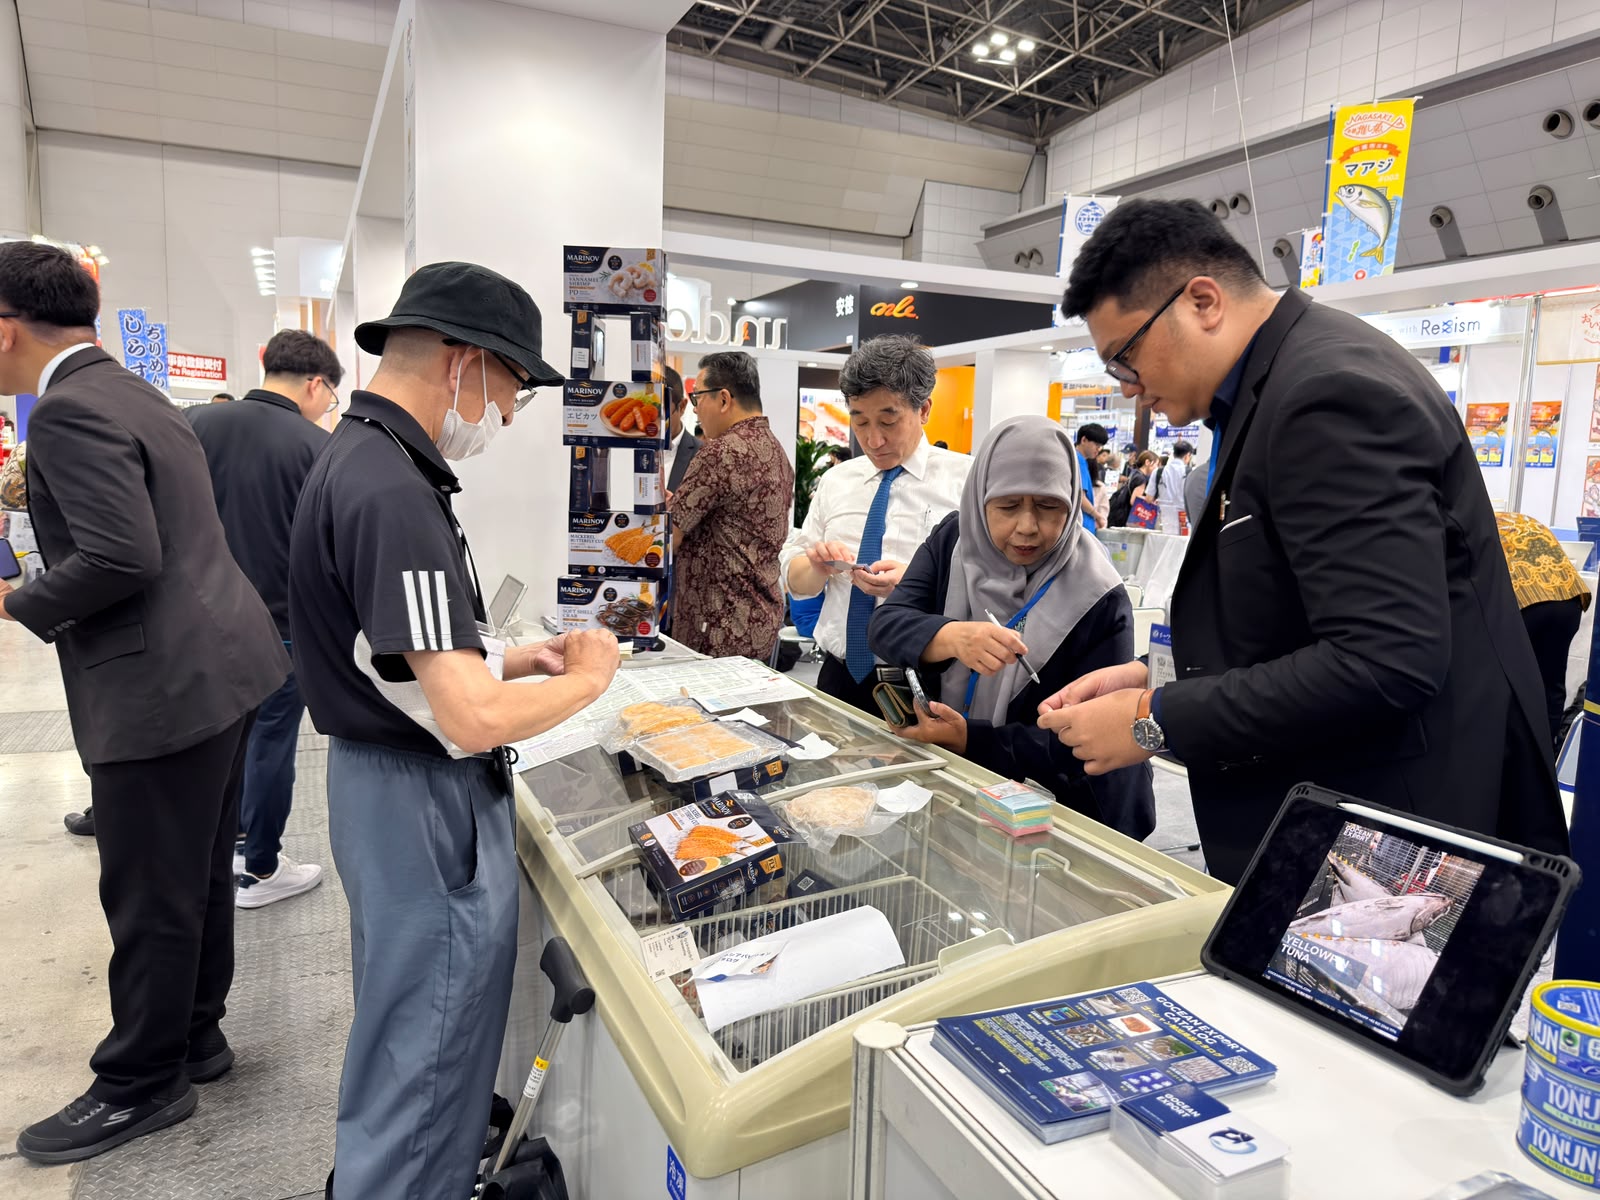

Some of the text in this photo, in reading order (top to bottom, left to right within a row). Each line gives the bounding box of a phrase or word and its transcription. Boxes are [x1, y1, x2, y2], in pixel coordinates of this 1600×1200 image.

[1346, 113, 1393, 125] NAGASAKI
[1344, 157, 1394, 177] マアジ
[567, 254, 599, 262] MARINOV
[146, 325, 165, 389] ちりめん
[168, 354, 222, 371] 事前登録受付
[168, 367, 223, 379] Pre Registration
[567, 387, 603, 395] MARINOV
[567, 412, 598, 420] エビカツ
[560, 586, 593, 594] MARINOV
[1281, 943, 1311, 964] TUNA
[1285, 935, 1350, 969] YELLOWFN
[1156, 996, 1248, 1053] GOCEAN EXPORT
[1163, 1011, 1218, 1045] CATALOG
[1156, 1096, 1191, 1118] EXPORT
[1164, 1093, 1201, 1118] GOCEAN
[1530, 1119, 1598, 1175] TONIJN
